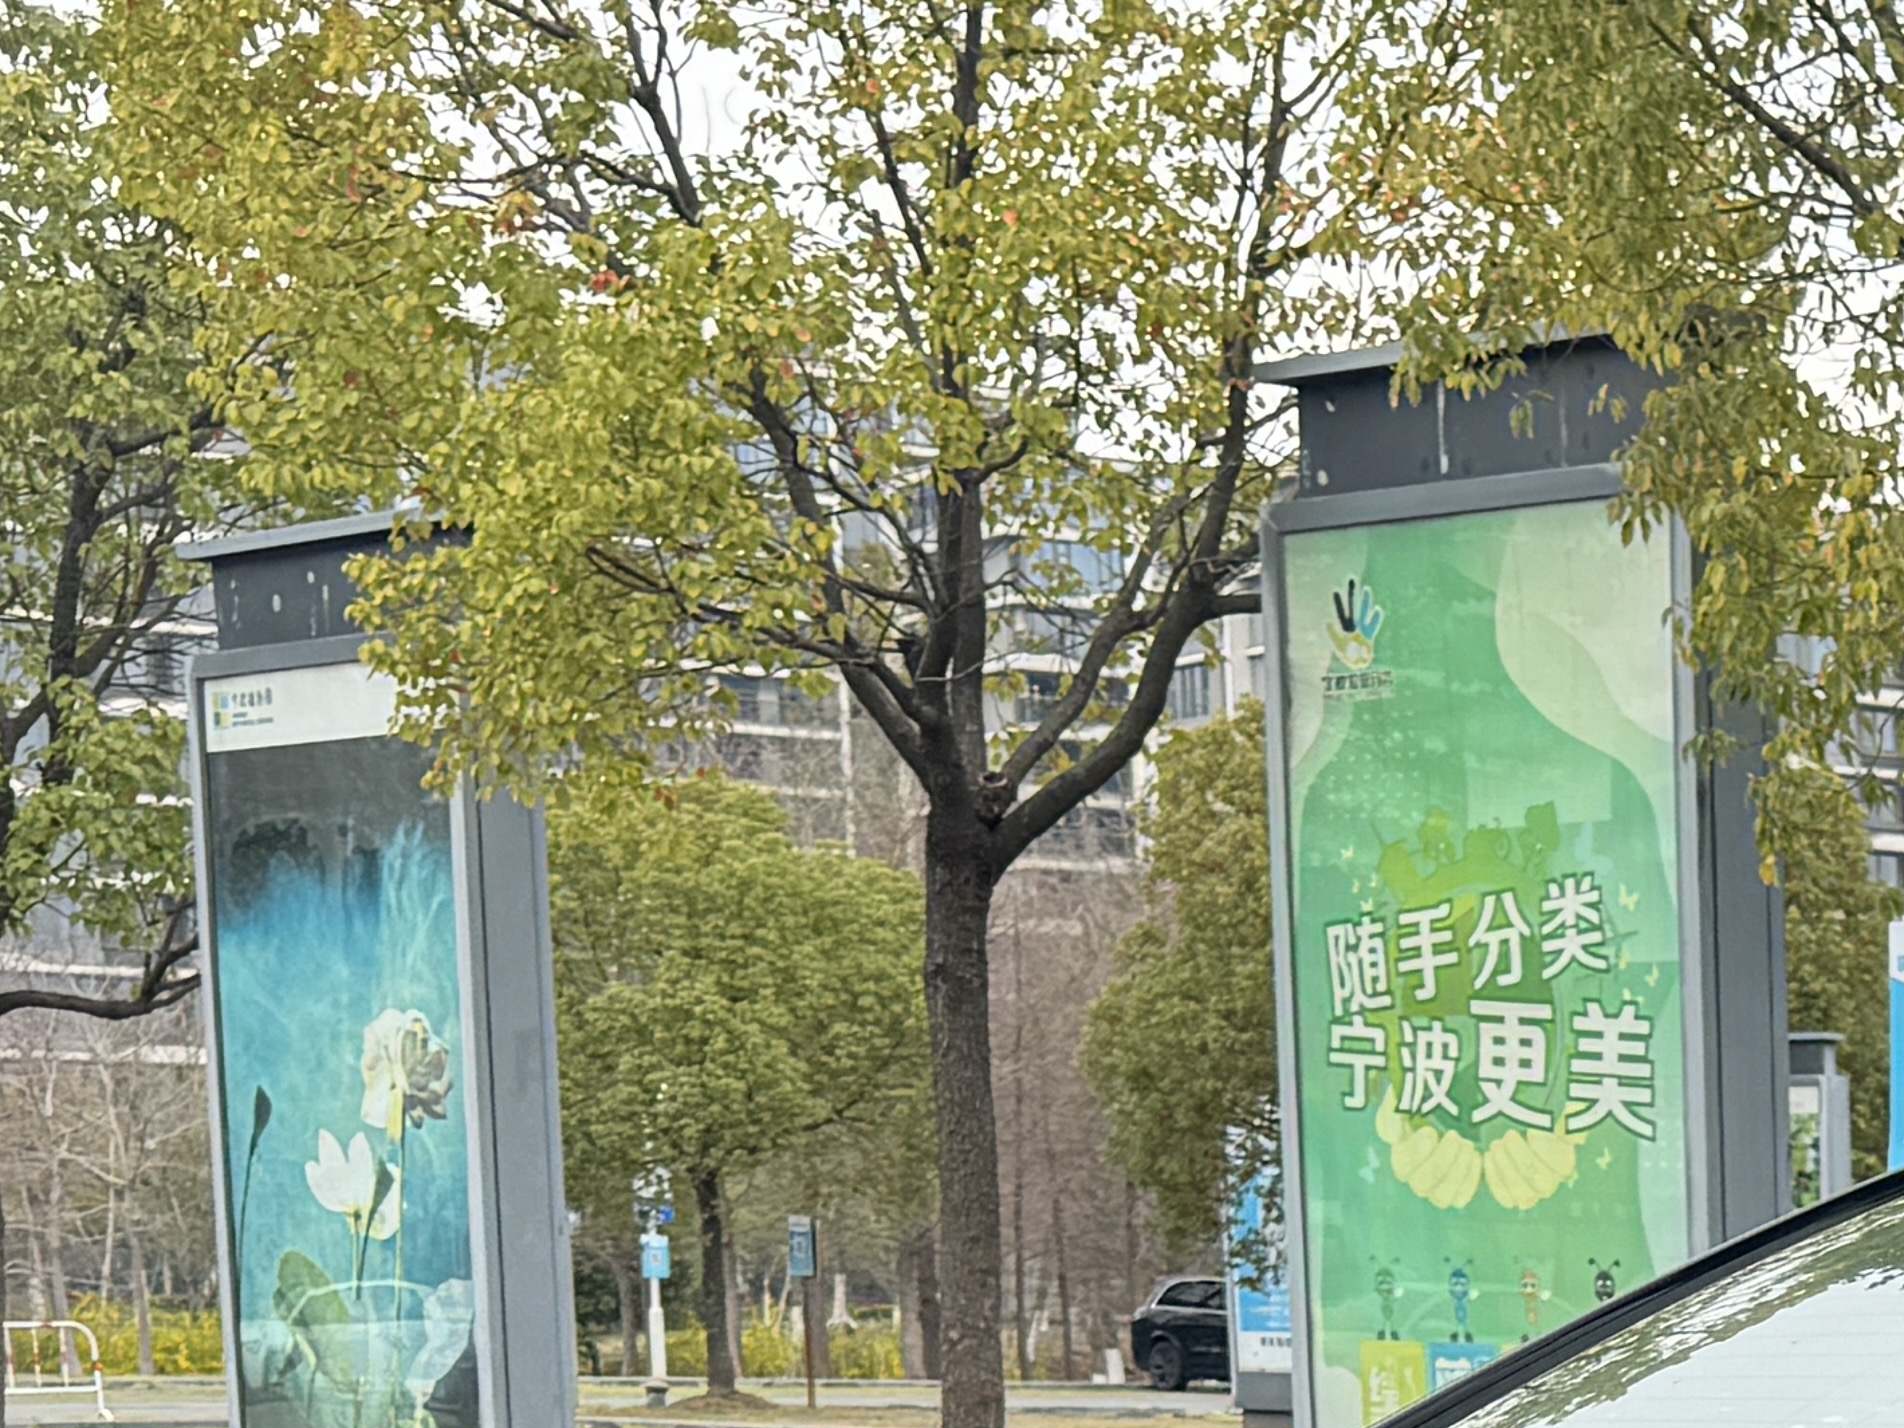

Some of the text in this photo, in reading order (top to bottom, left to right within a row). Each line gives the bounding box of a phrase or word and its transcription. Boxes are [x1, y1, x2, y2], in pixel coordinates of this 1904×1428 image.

[1324, 868, 1611, 1018] 随手分类
[1327, 998, 1657, 1141] 宁波更美
